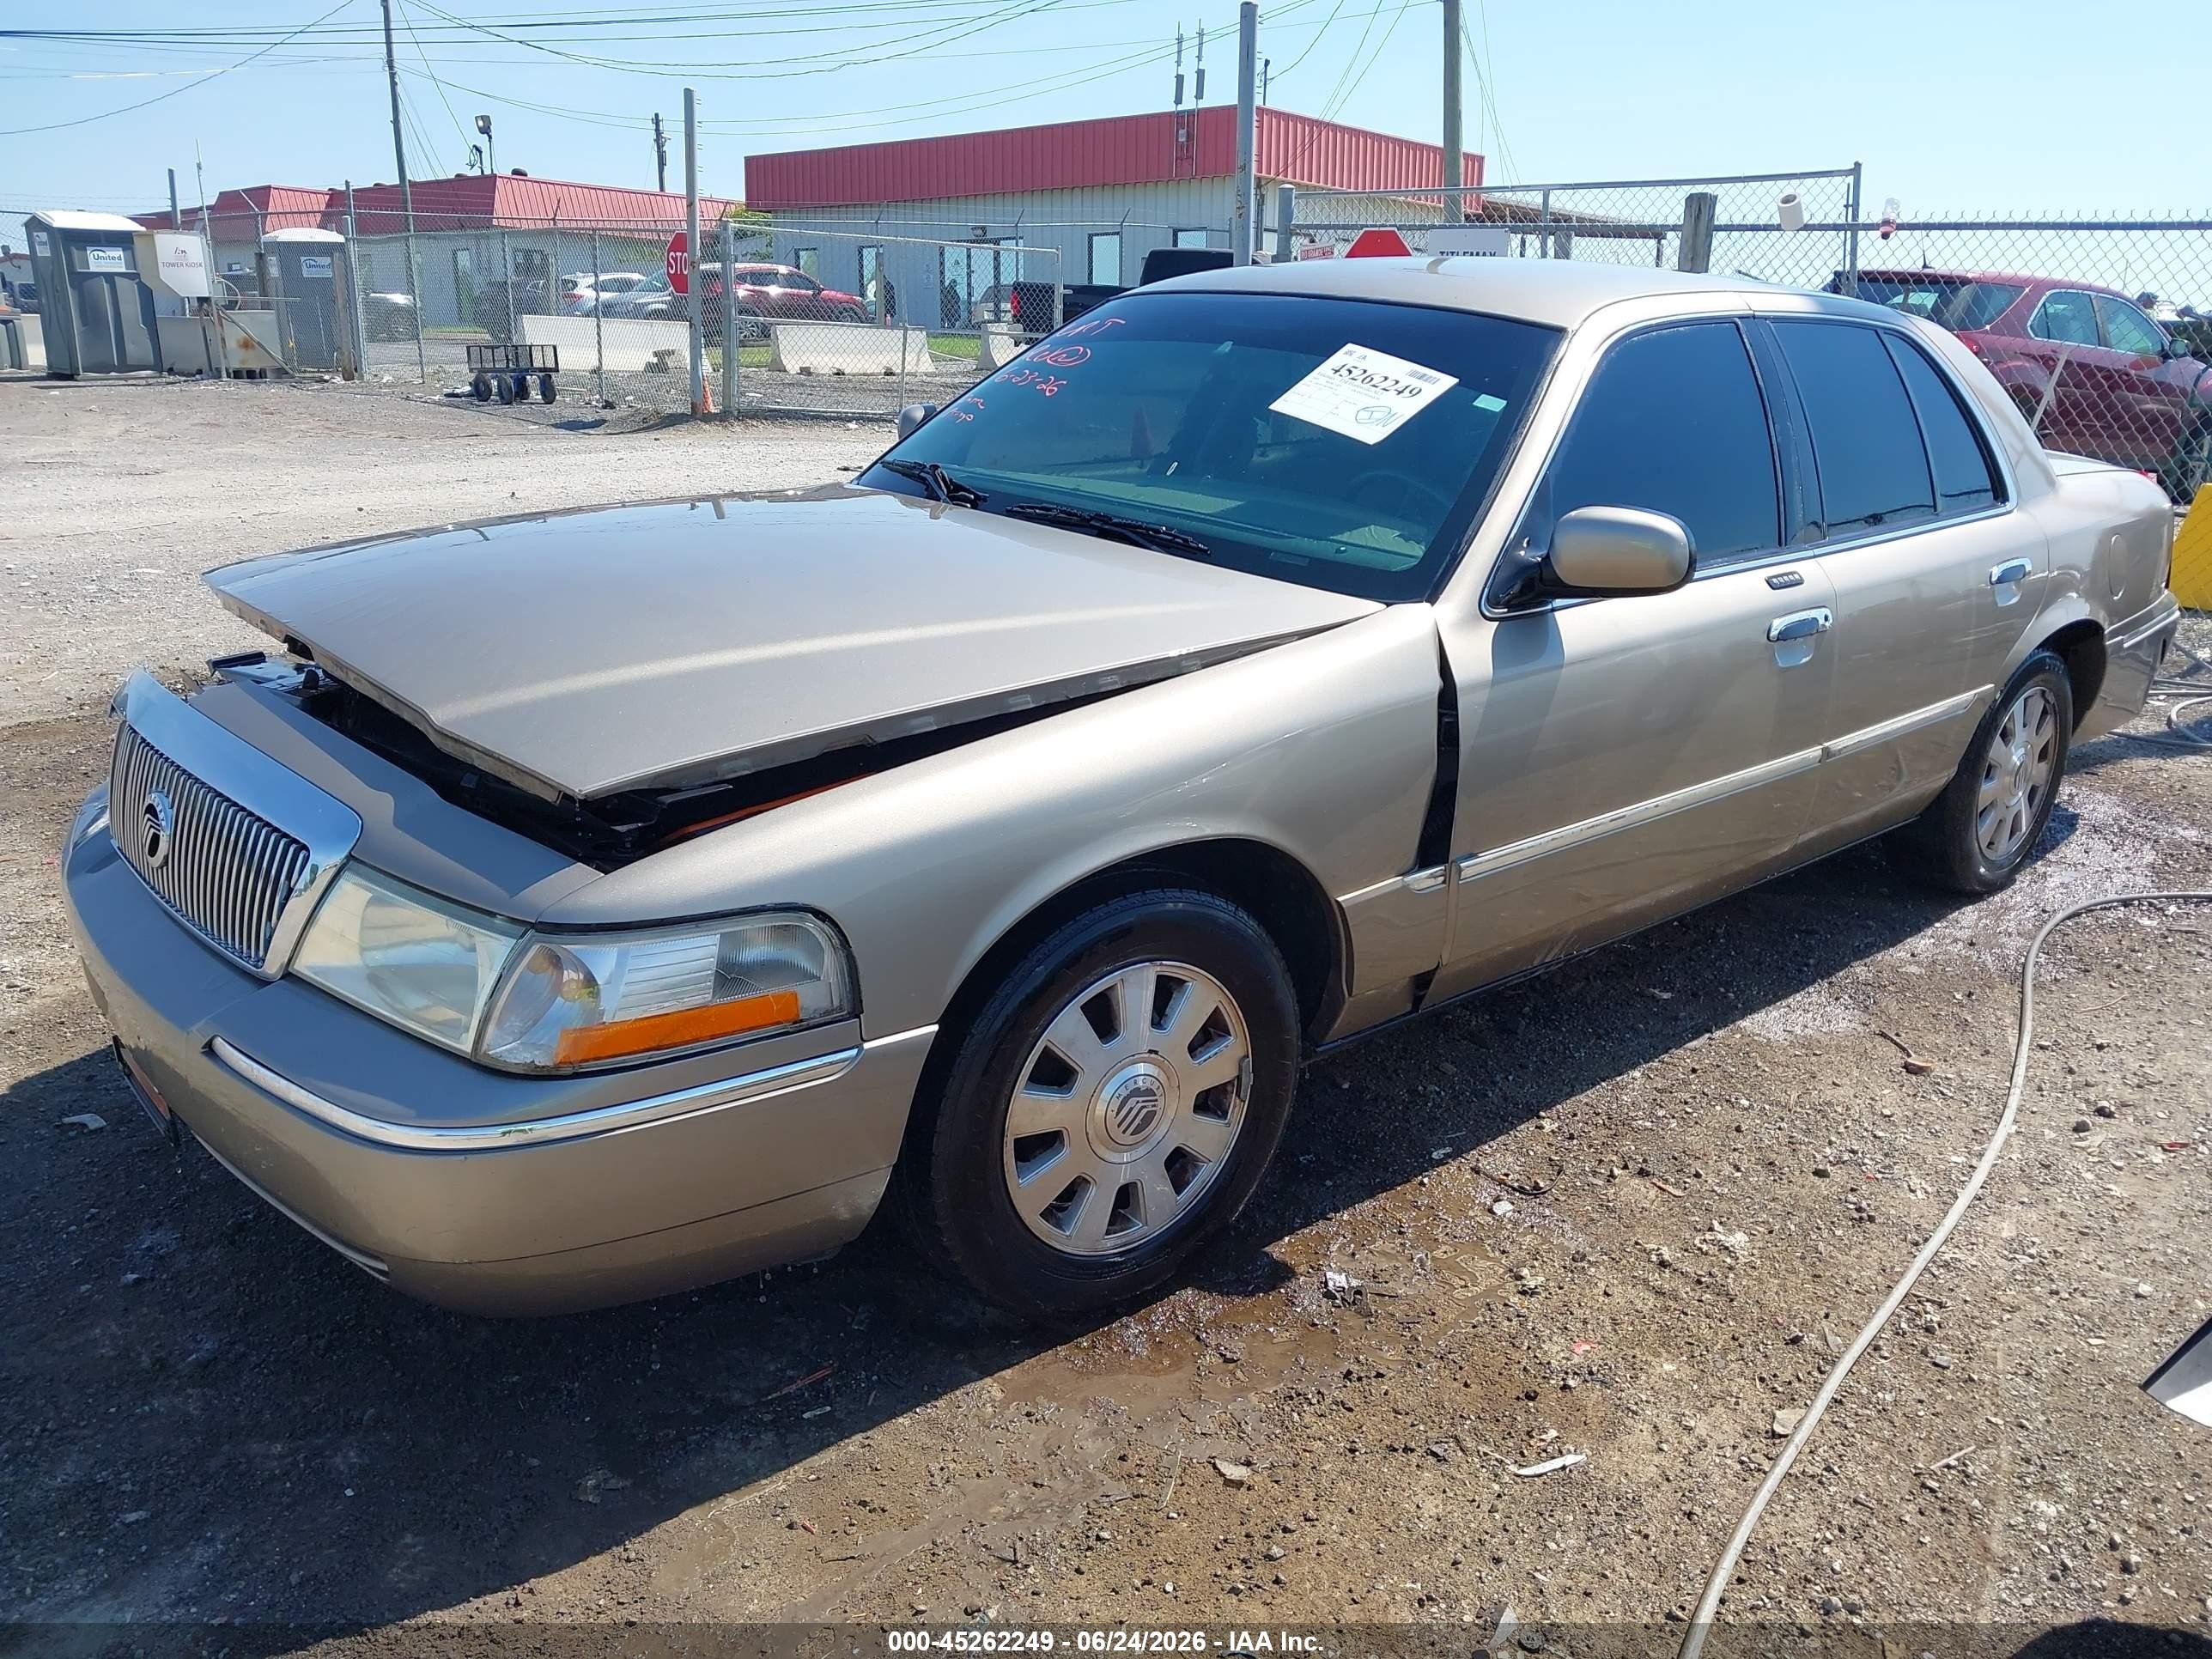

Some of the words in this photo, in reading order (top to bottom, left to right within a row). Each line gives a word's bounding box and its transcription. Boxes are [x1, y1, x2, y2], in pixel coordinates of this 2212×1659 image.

[92, 252, 122, 261] United
[668, 251, 688, 275] STO
[1331, 362, 1422, 398] 45262249
